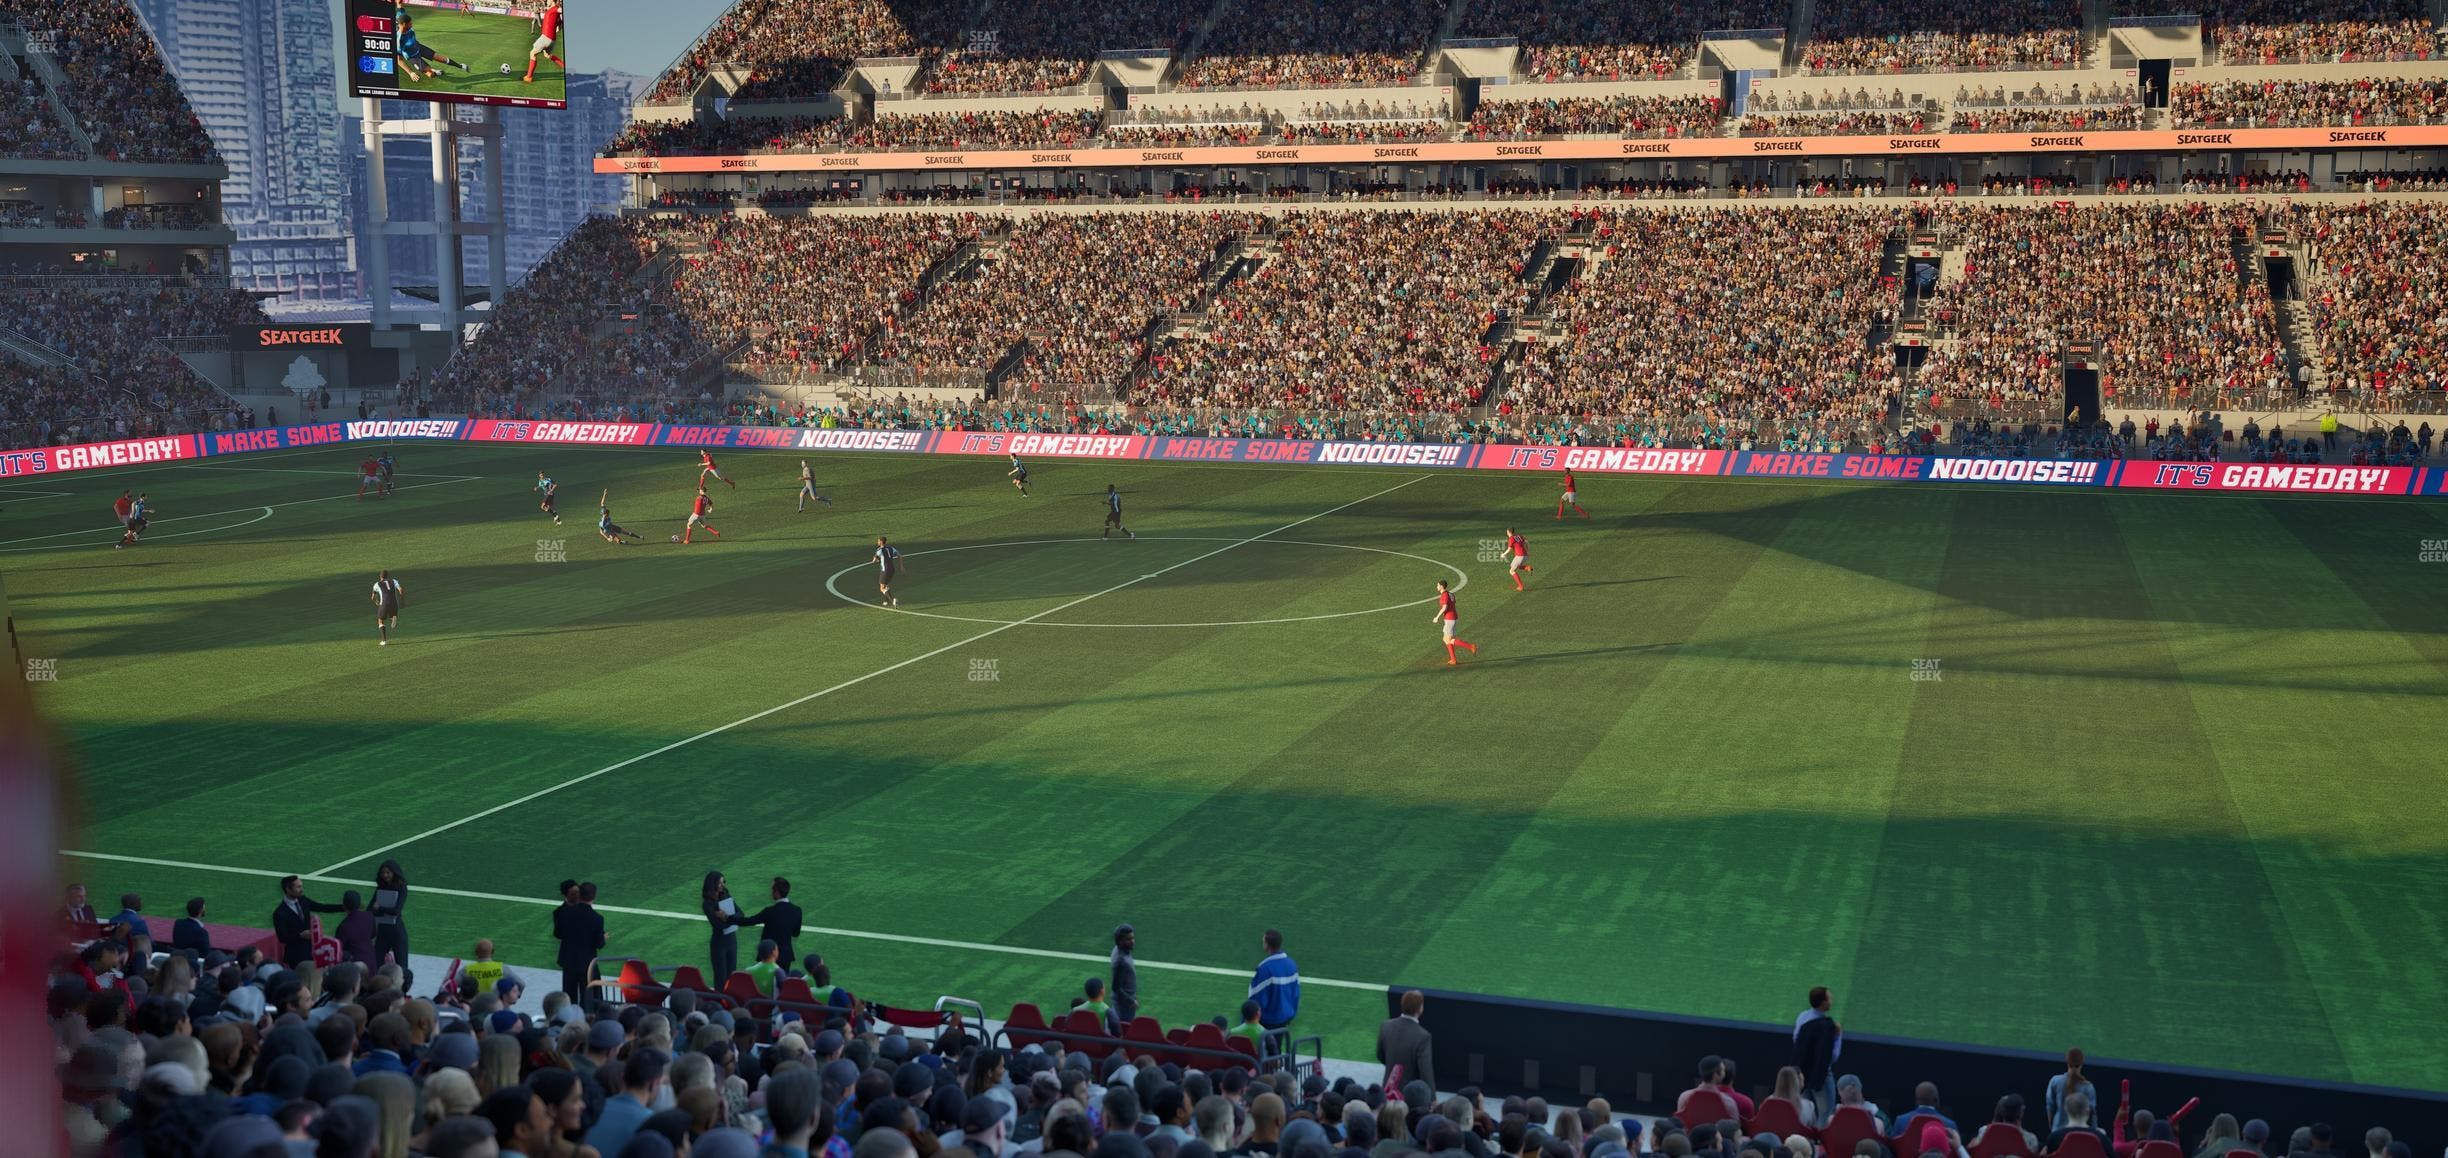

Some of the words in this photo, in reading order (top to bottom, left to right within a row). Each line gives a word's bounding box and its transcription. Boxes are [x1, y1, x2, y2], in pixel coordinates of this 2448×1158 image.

[364, 39, 391, 51] 90:00
[380, 61, 387, 71] 2
[2031, 136, 2084, 147] SEATGEEK
[2177, 133, 2232, 145] SEATGEEK
[2329, 131, 2386, 143] SEATGEEK
[1623, 143, 1670, 154] SEATGEEK
[1754, 141, 1803, 152] SEATGEEK
[1889, 139, 1941, 149] SEATGEEK
[1256, 150, 1299, 160] SEATGEEK
[1374, 148, 1418, 158] SEATGEEK
[1496, 146, 1542, 156] SEATGEEK
[822, 158, 859, 167] SEATGEEK
[925, 155, 964, 165] SEATGEEK
[1032, 154, 1071, 164] SEATGEEK
[1142, 152, 1183, 162] SEATGEEK
[625, 161, 659, 170] SEATGEEK
[721, 160, 758, 168] SEATGEEK
[259, 328, 343, 346] SEATGEEK
[216, 429, 279, 453] MAKE
[287, 423, 342, 446] SOME
[346, 420, 459, 440] NOOOOISE!!!
[490, 421, 530, 440] IT'S
[532, 423, 639, 443] GAMEDAY!
[666, 426, 727, 446] MAKE
[735, 427, 797, 448] SOME
[798, 430, 922, 450] NOOOOISE!!!
[960, 434, 1004, 452] IT'S
[1008, 435, 1128, 457] GAMEDAY!
[56, 438, 181, 470] GAMEDAY!
[1163, 438, 1234, 460] MAKE
[1245, 441, 1314, 462] SOME
[1317, 442, 1462, 465] NOOOOISE!!!
[1507, 448, 1558, 468] IT'S
[1564, 449, 1707, 473] GAMEDAY!
[1746, 454, 1830, 476] MAKE
[1842, 456, 1924, 479] SOME
[1928, 458, 2098, 483] NOOOOISE!!!
[2153, 463, 2215, 486] IT'S
[2221, 465, 2390, 491] GAMEDAY!
